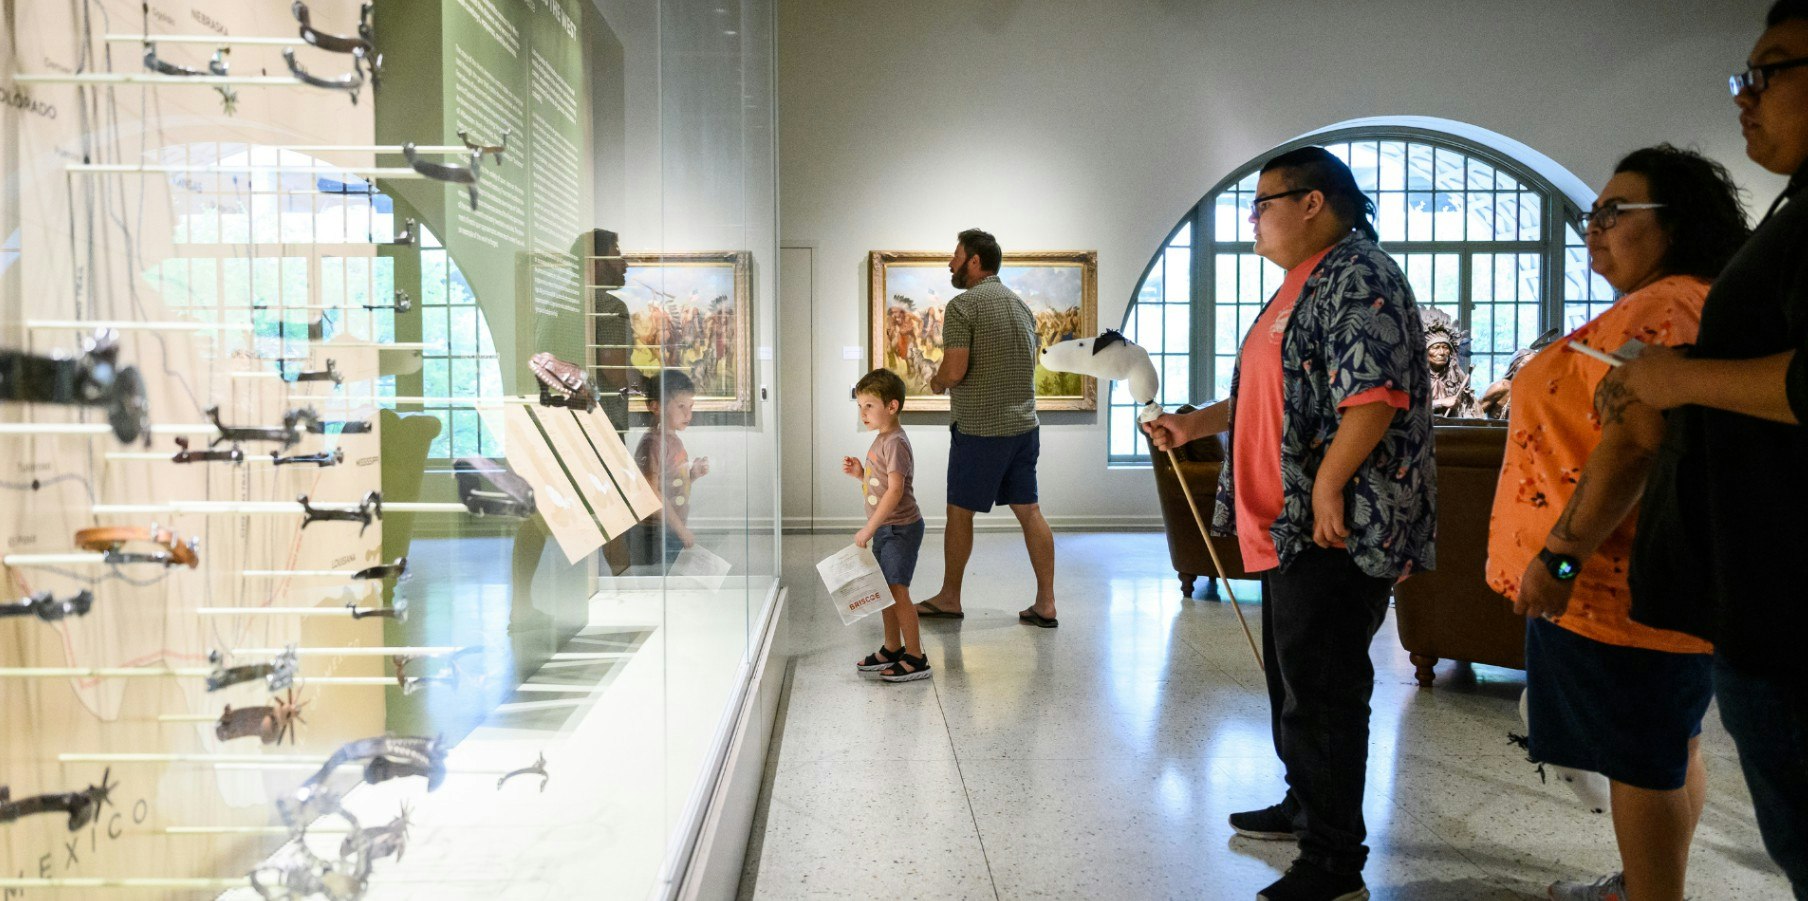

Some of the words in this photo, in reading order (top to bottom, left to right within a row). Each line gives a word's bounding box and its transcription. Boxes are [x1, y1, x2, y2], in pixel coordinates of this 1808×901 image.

[191, 8, 229, 36] NEBRASKA
[561, 8, 577, 42] WEST
[849, 592, 881, 610] BRISCOE
[4, 798, 148, 901] MEXICO
